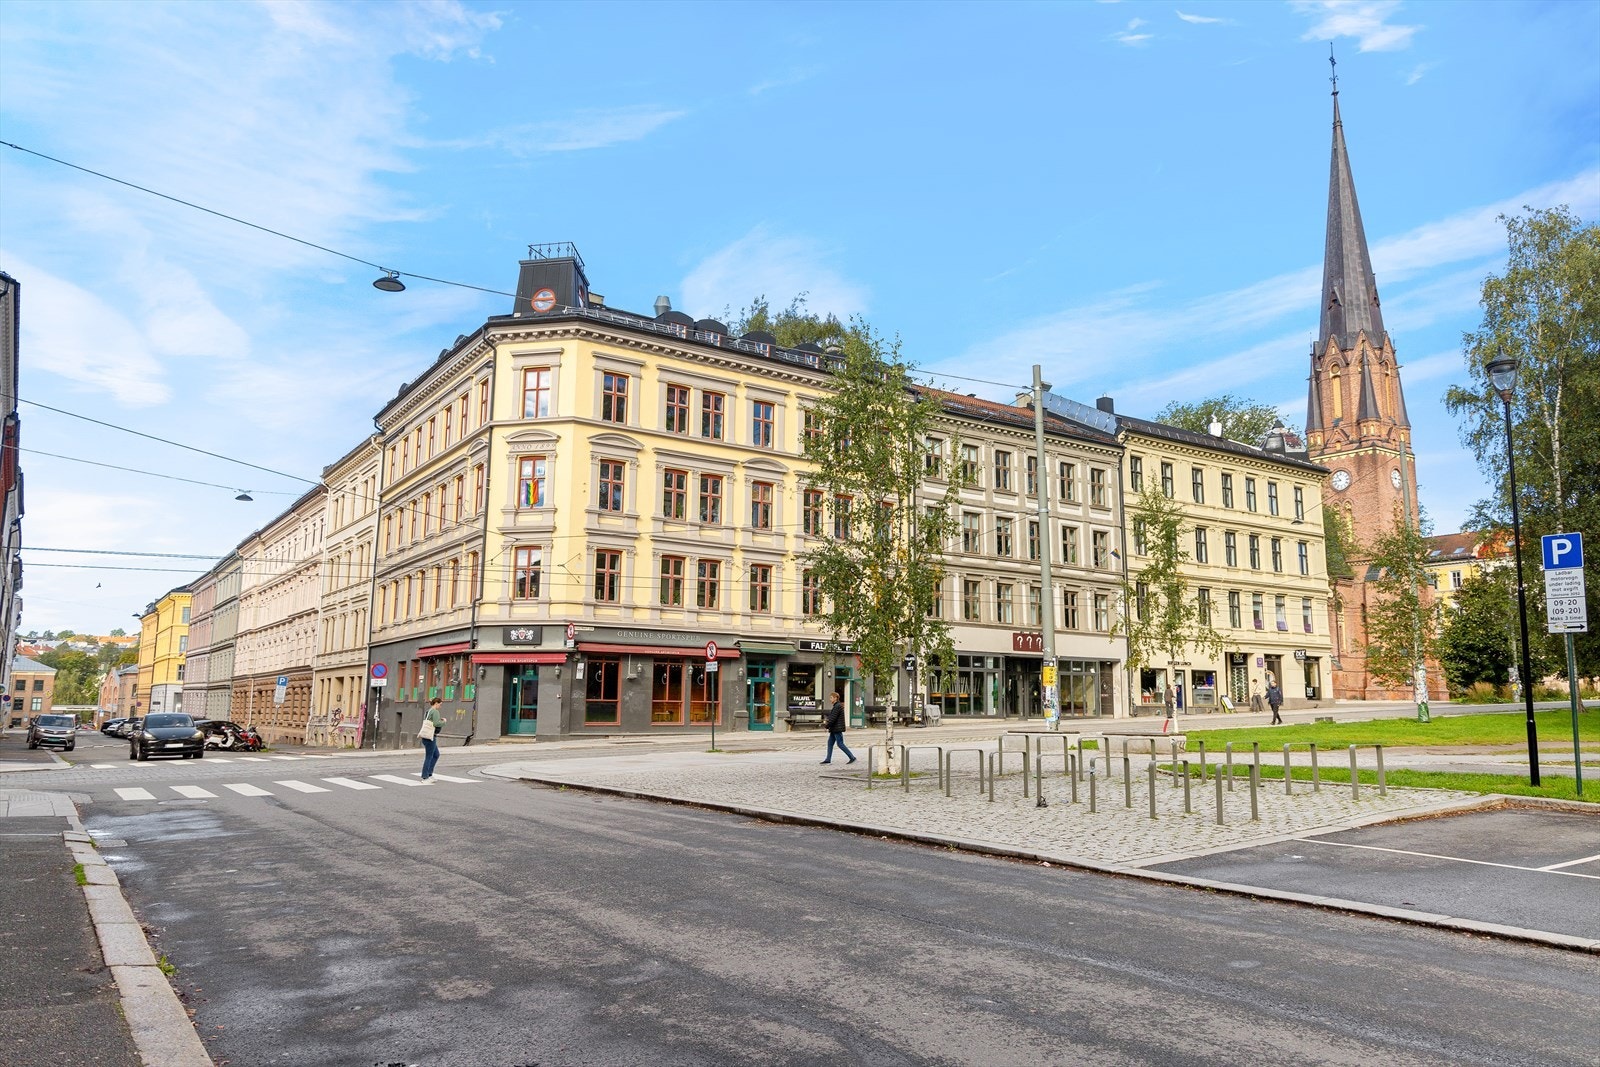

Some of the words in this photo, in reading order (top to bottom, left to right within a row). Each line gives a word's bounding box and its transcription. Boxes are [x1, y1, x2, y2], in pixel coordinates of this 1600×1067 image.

[1551, 538, 1572, 565] P
[617, 630, 653, 639] GENUINE
[656, 633, 701, 642] SPORTSPUB
[279, 677, 286, 685] P
